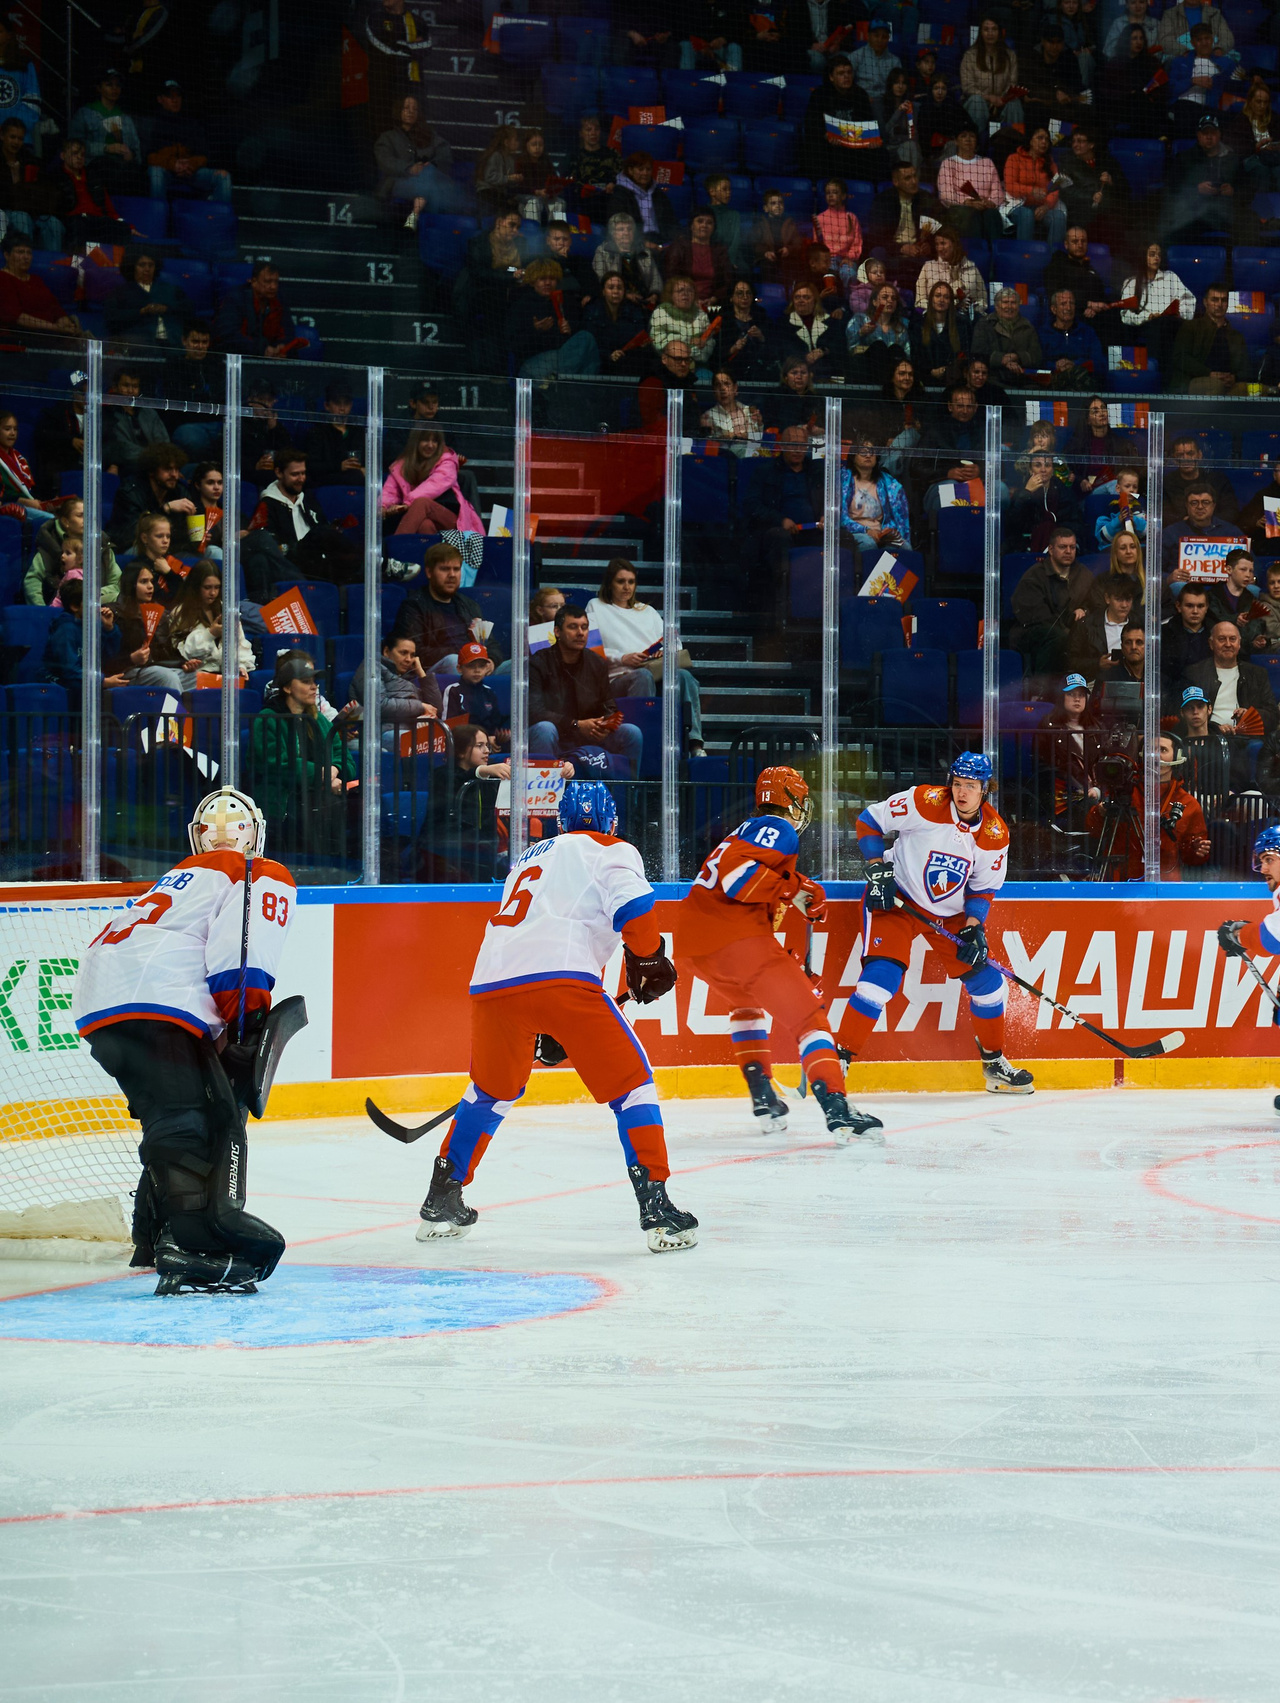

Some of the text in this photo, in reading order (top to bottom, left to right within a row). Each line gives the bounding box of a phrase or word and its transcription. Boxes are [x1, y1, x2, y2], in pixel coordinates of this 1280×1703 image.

[450, 56, 475, 74] 17
[495, 110, 520, 128] 16
[327, 203, 352, 226] 14
[366, 262, 394, 284] 13
[411, 321, 438, 345] 12
[458, 386, 480, 407] 11
[761, 791, 771, 802] 13
[754, 826, 780, 848] 13
[930, 852, 969, 875] СХЛ
[489, 864, 543, 927] 6
[262, 891, 290, 928] 83
